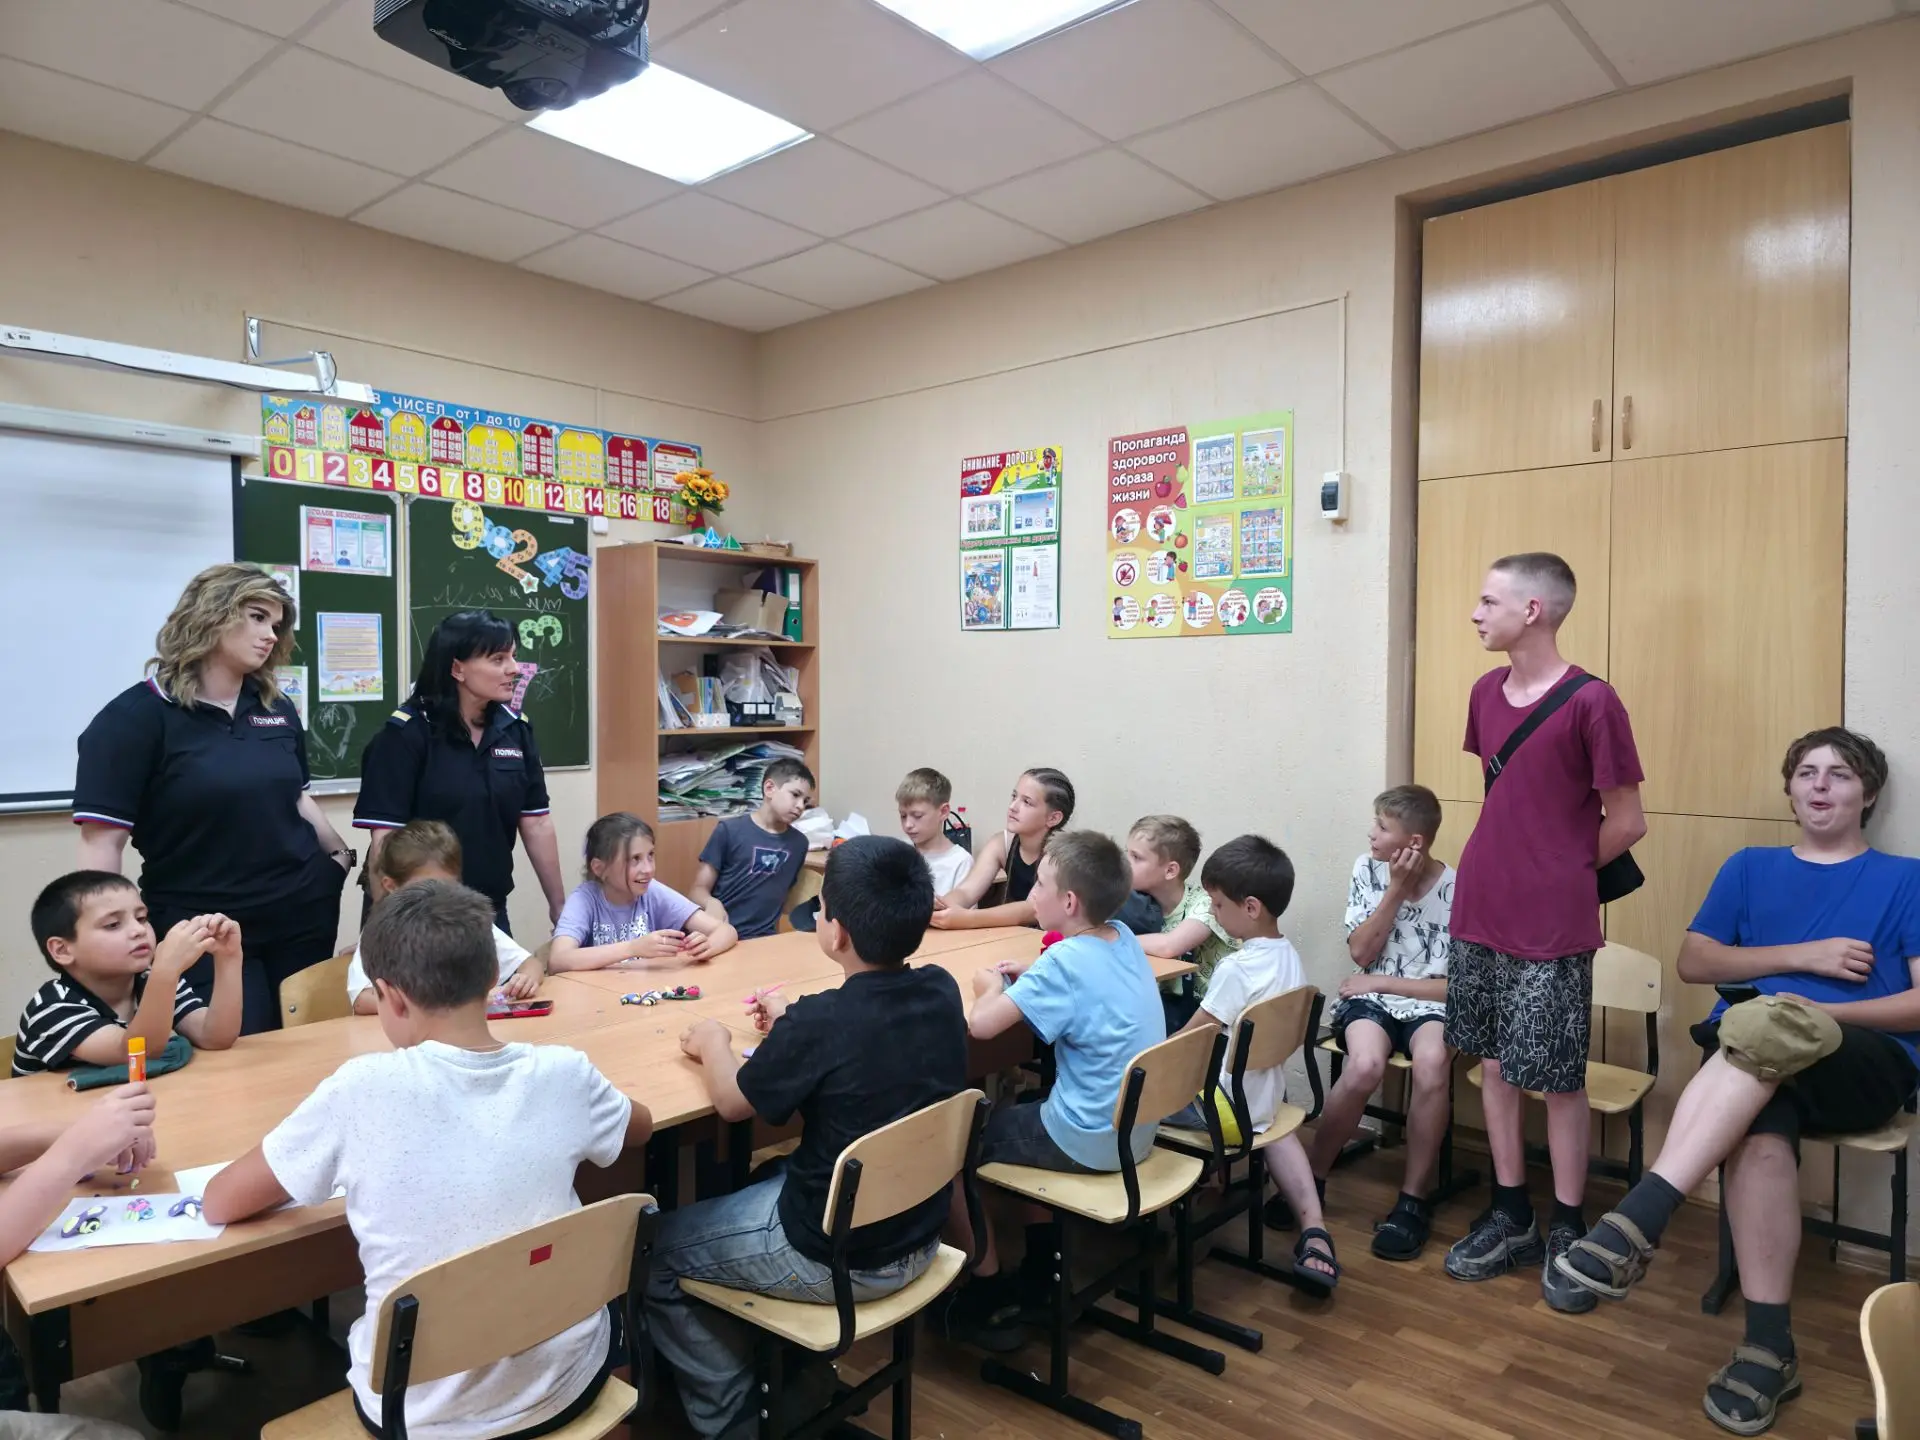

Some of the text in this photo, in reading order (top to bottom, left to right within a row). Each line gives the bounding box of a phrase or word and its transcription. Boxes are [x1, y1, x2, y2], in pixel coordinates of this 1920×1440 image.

[393, 396, 445, 416] ЧИСЕЛ
[456, 409, 470, 420] от
[474, 411, 480, 422] 1
[486, 415, 503, 426] до
[507, 416, 521, 429] 10
[1113, 432, 1186, 454] Пропаганда
[962, 454, 1003, 472] ВНИМАНИЕ,
[1112, 451, 1177, 471] здорового
[273, 450, 293, 475] 0
[302, 454, 317, 478] 1
[326, 455, 346, 481] 2
[353, 459, 369, 484] 3
[374, 462, 391, 487] 4
[400, 464, 415, 489] 5
[420, 468, 438, 492] 6
[444, 471, 459, 494] 7
[466, 474, 483, 498] 8
[487, 476, 502, 499] 9
[505, 478, 524, 503] 10
[527, 482, 544, 505] 11
[546, 484, 564, 508] 12
[566, 487, 584, 510] 13
[585, 489, 604, 514] 14
[606, 491, 621, 514] 15
[620, 493, 636, 516] 16
[637, 495, 651, 517] 17
[654, 497, 670, 519] 18
[1112, 472, 1154, 487] образа
[1112, 489, 1150, 503] жизни
[451, 500, 484, 550] 9
[496, 529, 538, 581] 2
[560, 552, 592, 600] 5
